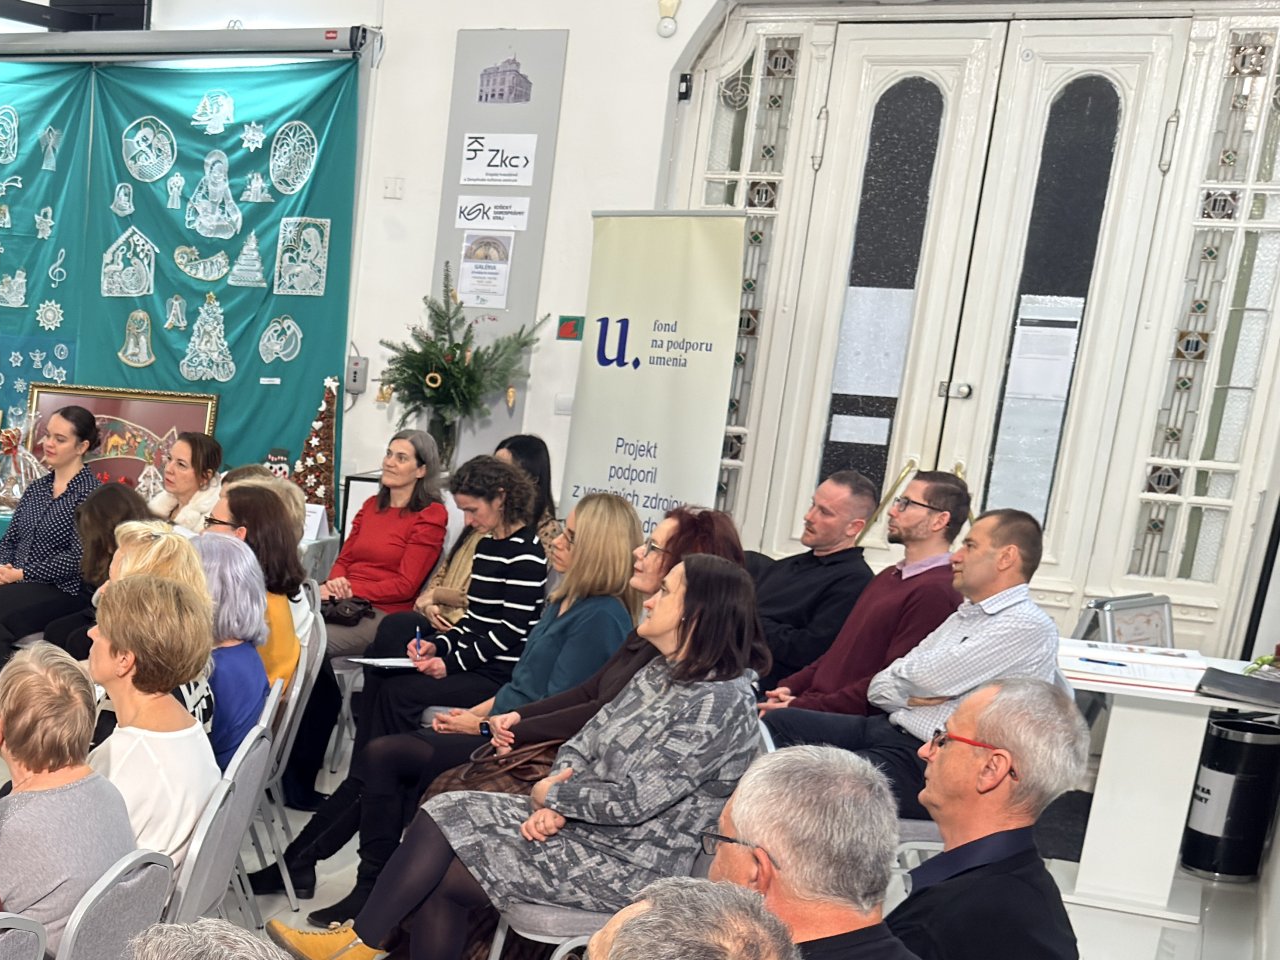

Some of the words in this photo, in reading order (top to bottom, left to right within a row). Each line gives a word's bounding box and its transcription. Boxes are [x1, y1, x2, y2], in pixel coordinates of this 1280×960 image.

[653, 320, 678, 333] fond
[651, 338, 664, 349] na
[666, 338, 713, 353] podporu
[648, 354, 688, 368] umenia
[615, 437, 658, 461] Projekt
[608, 465, 657, 485] podporil
[572, 485, 581, 498] z
